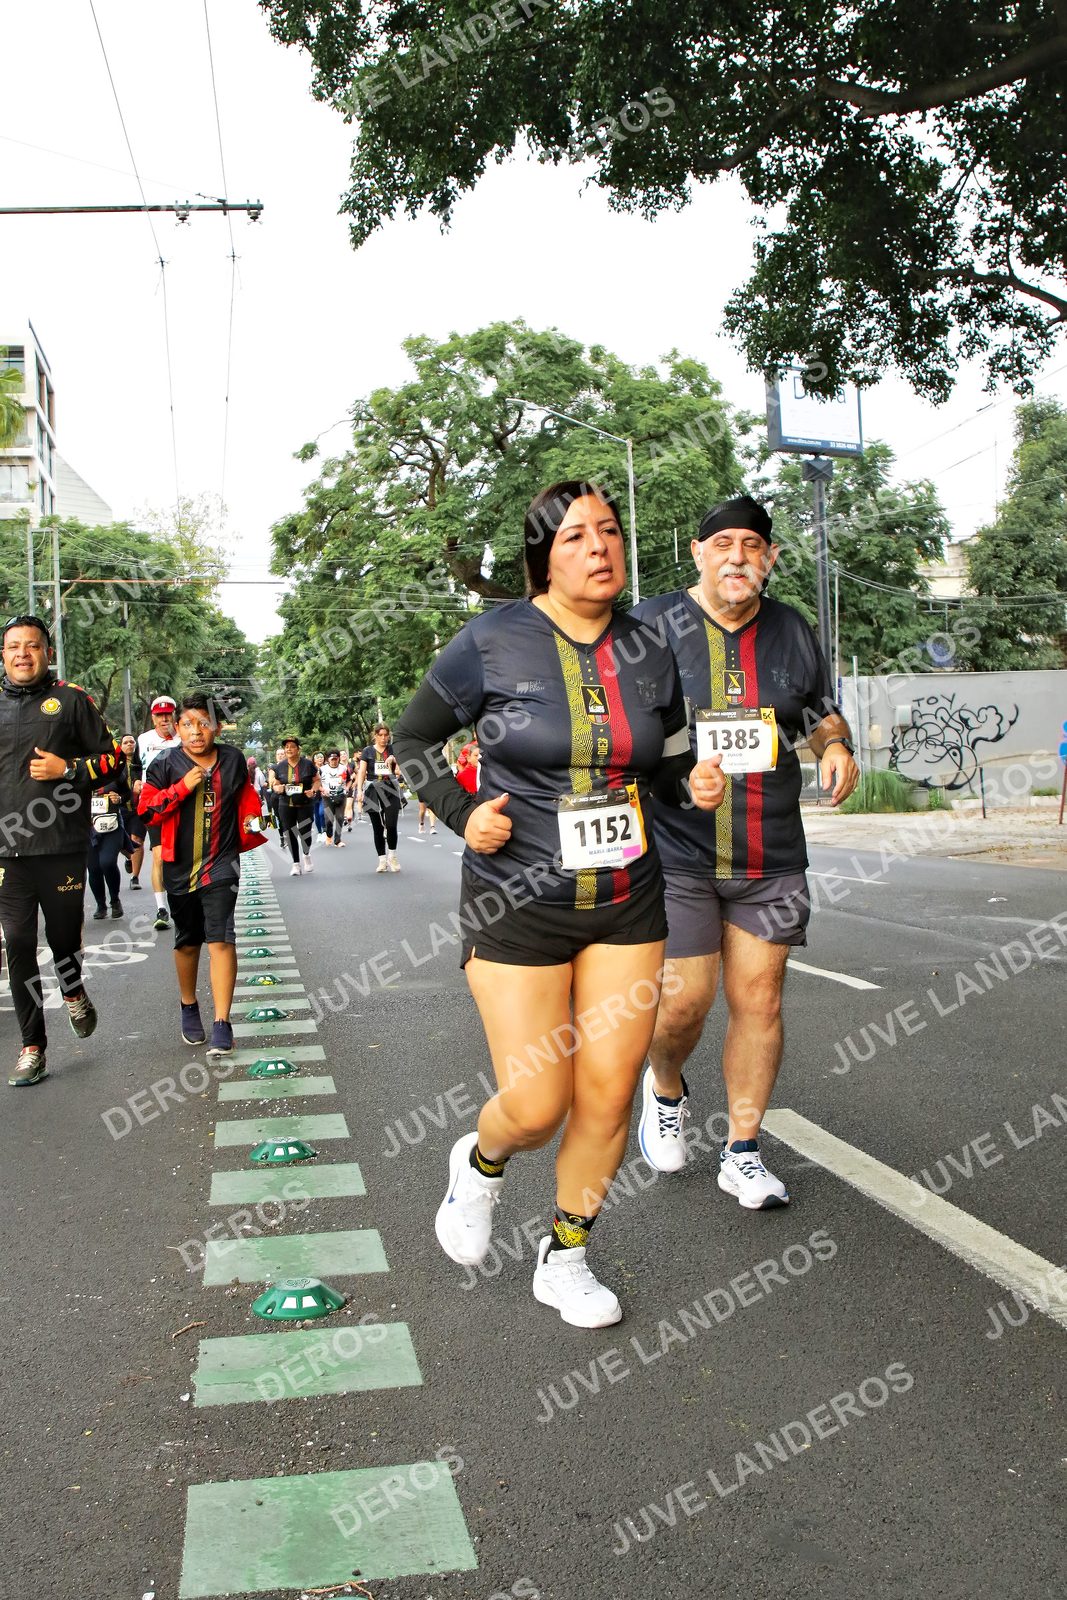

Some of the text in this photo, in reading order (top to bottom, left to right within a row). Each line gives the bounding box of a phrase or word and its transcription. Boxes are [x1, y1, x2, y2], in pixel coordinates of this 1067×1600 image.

[912, 693, 956, 709] TOY
[708, 728, 760, 750] 1385
[574, 814, 632, 848] 1152
